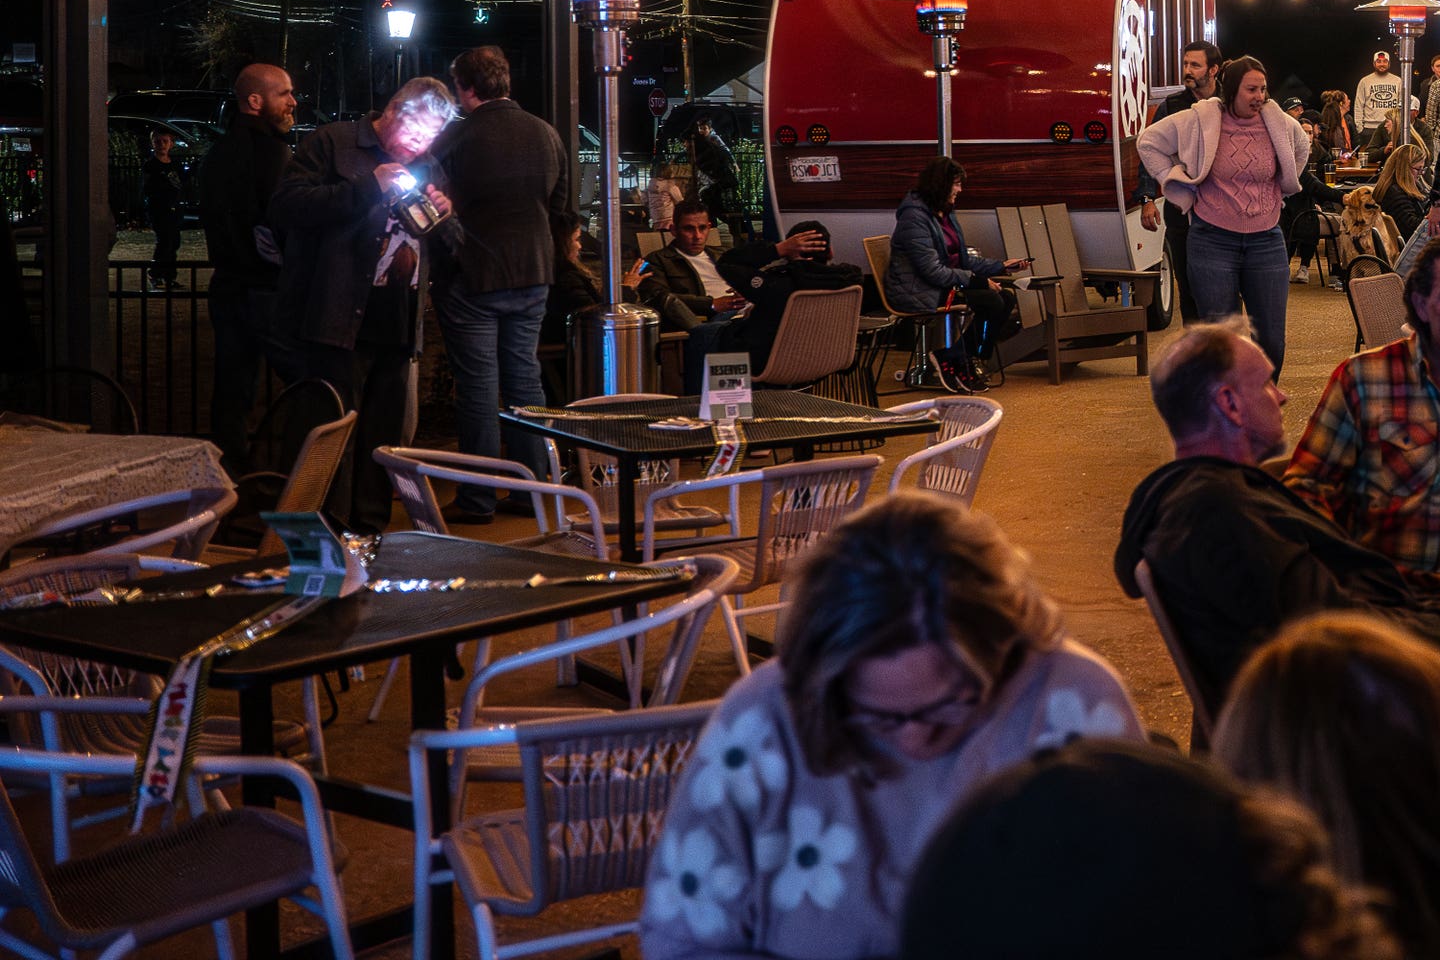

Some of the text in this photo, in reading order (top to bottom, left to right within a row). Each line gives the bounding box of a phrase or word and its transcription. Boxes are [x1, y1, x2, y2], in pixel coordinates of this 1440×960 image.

[1370, 84, 1397, 94] AUBURN
[650, 97, 665, 108] STOP
[1370, 98, 1397, 109] TIGERS
